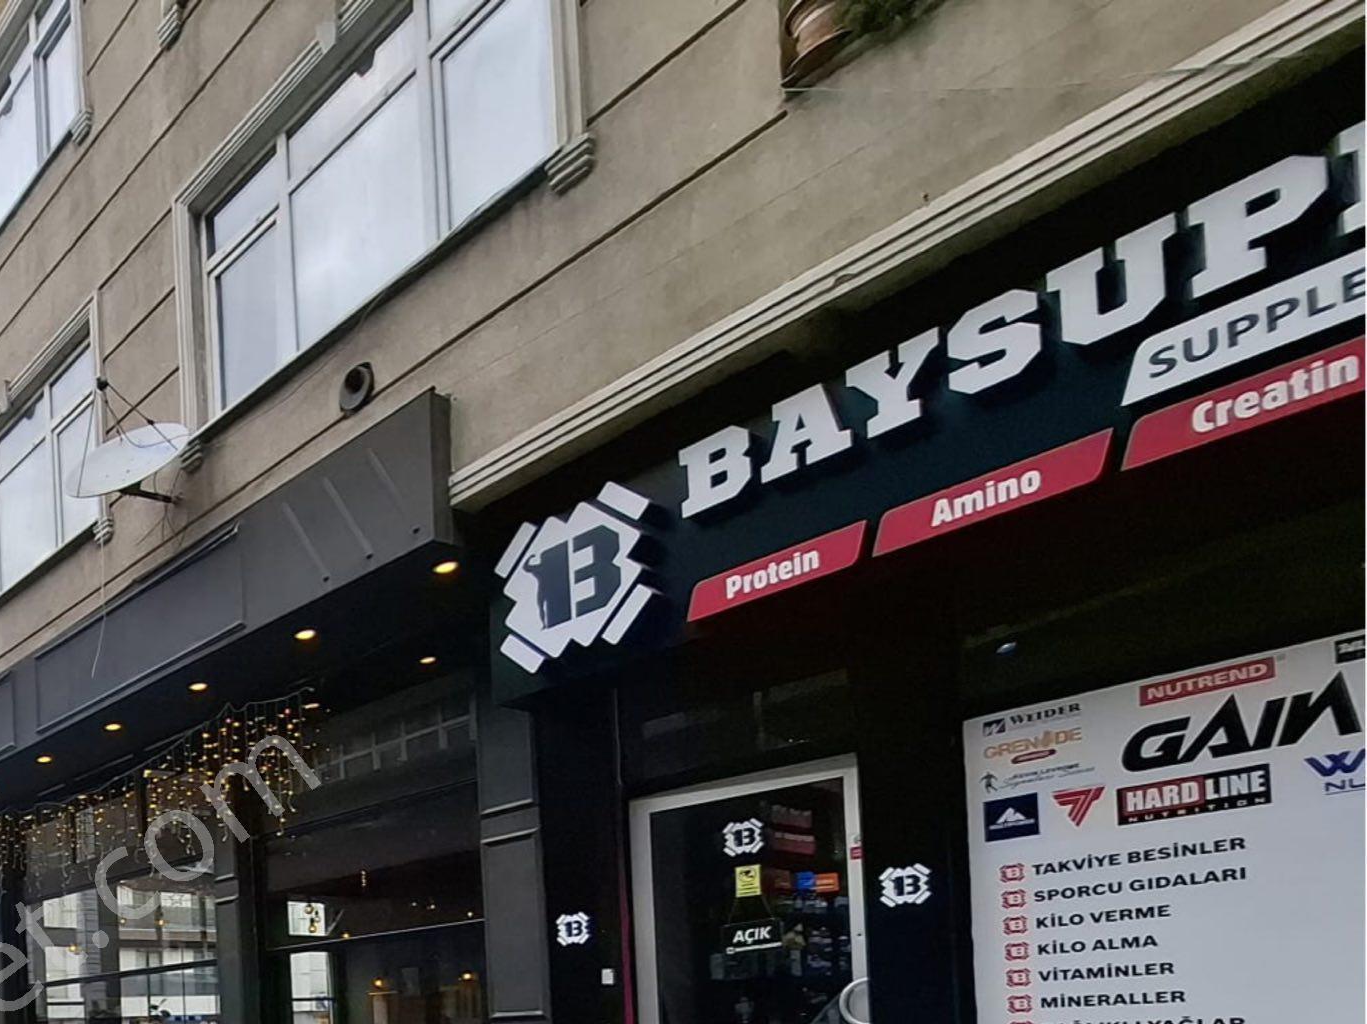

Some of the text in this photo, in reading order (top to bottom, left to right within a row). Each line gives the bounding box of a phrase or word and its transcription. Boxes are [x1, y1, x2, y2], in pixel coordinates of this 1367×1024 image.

[1191, 354, 1359, 433] Creatin
[930, 469, 1042, 527] Amino
[725, 549, 820, 600] Protein
[1146, 662, 1267, 700] NUTREND
[1125, 769, 1267, 813] HARD LINE
[1032, 836, 1247, 876] TAKVİYE BESİNLER
[1034, 867, 1247, 903] SPORCU GIDALARI
[733, 926, 772, 944] AÇIK
[1036, 904, 1172, 930] KİLO VERME
[1037, 935, 1159, 956] KİLO ALMA
[1038, 961, 1175, 983] VİTAMİNLER
[1040, 990, 1186, 1009] MİNERALLER
